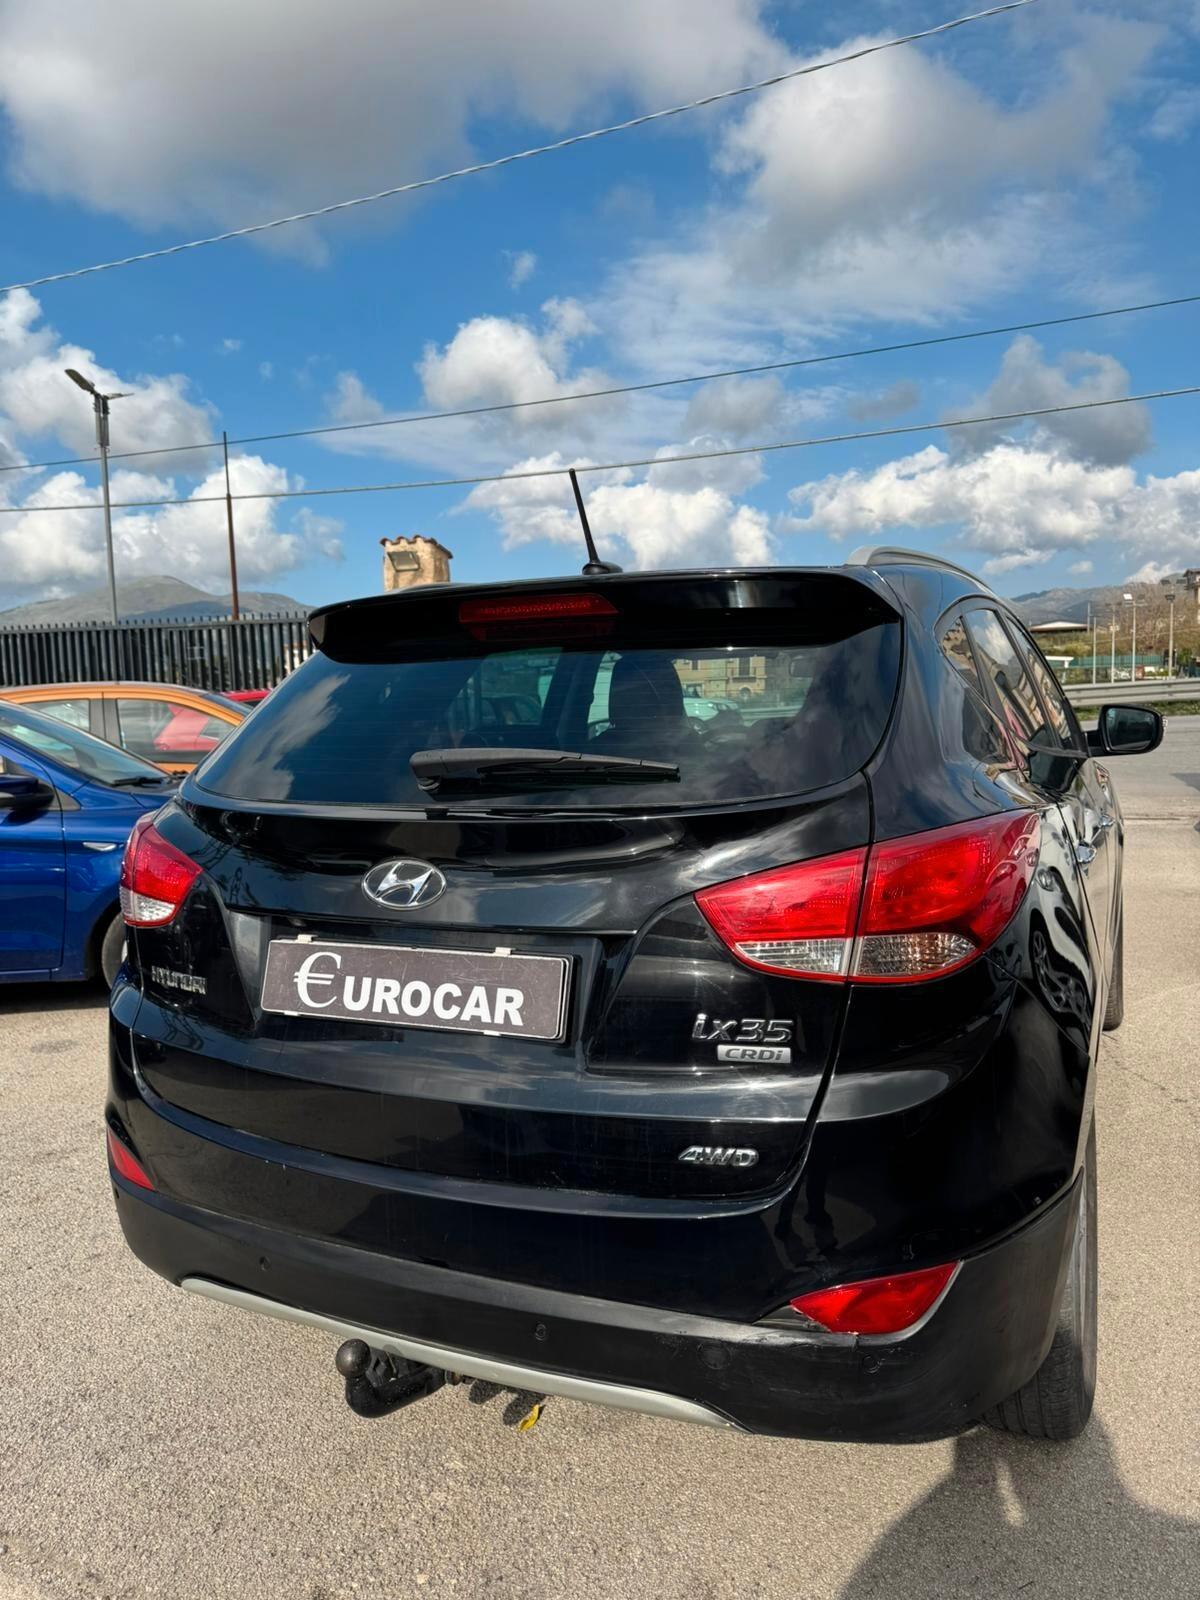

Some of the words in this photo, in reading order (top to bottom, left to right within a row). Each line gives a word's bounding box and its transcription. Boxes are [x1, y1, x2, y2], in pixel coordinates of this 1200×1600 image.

[151, 965, 207, 995] HYUNDAI
[692, 1013, 793, 1042] ix35
[725, 1048, 784, 1061] CRDi
[678, 1145, 759, 1167] 4WD
